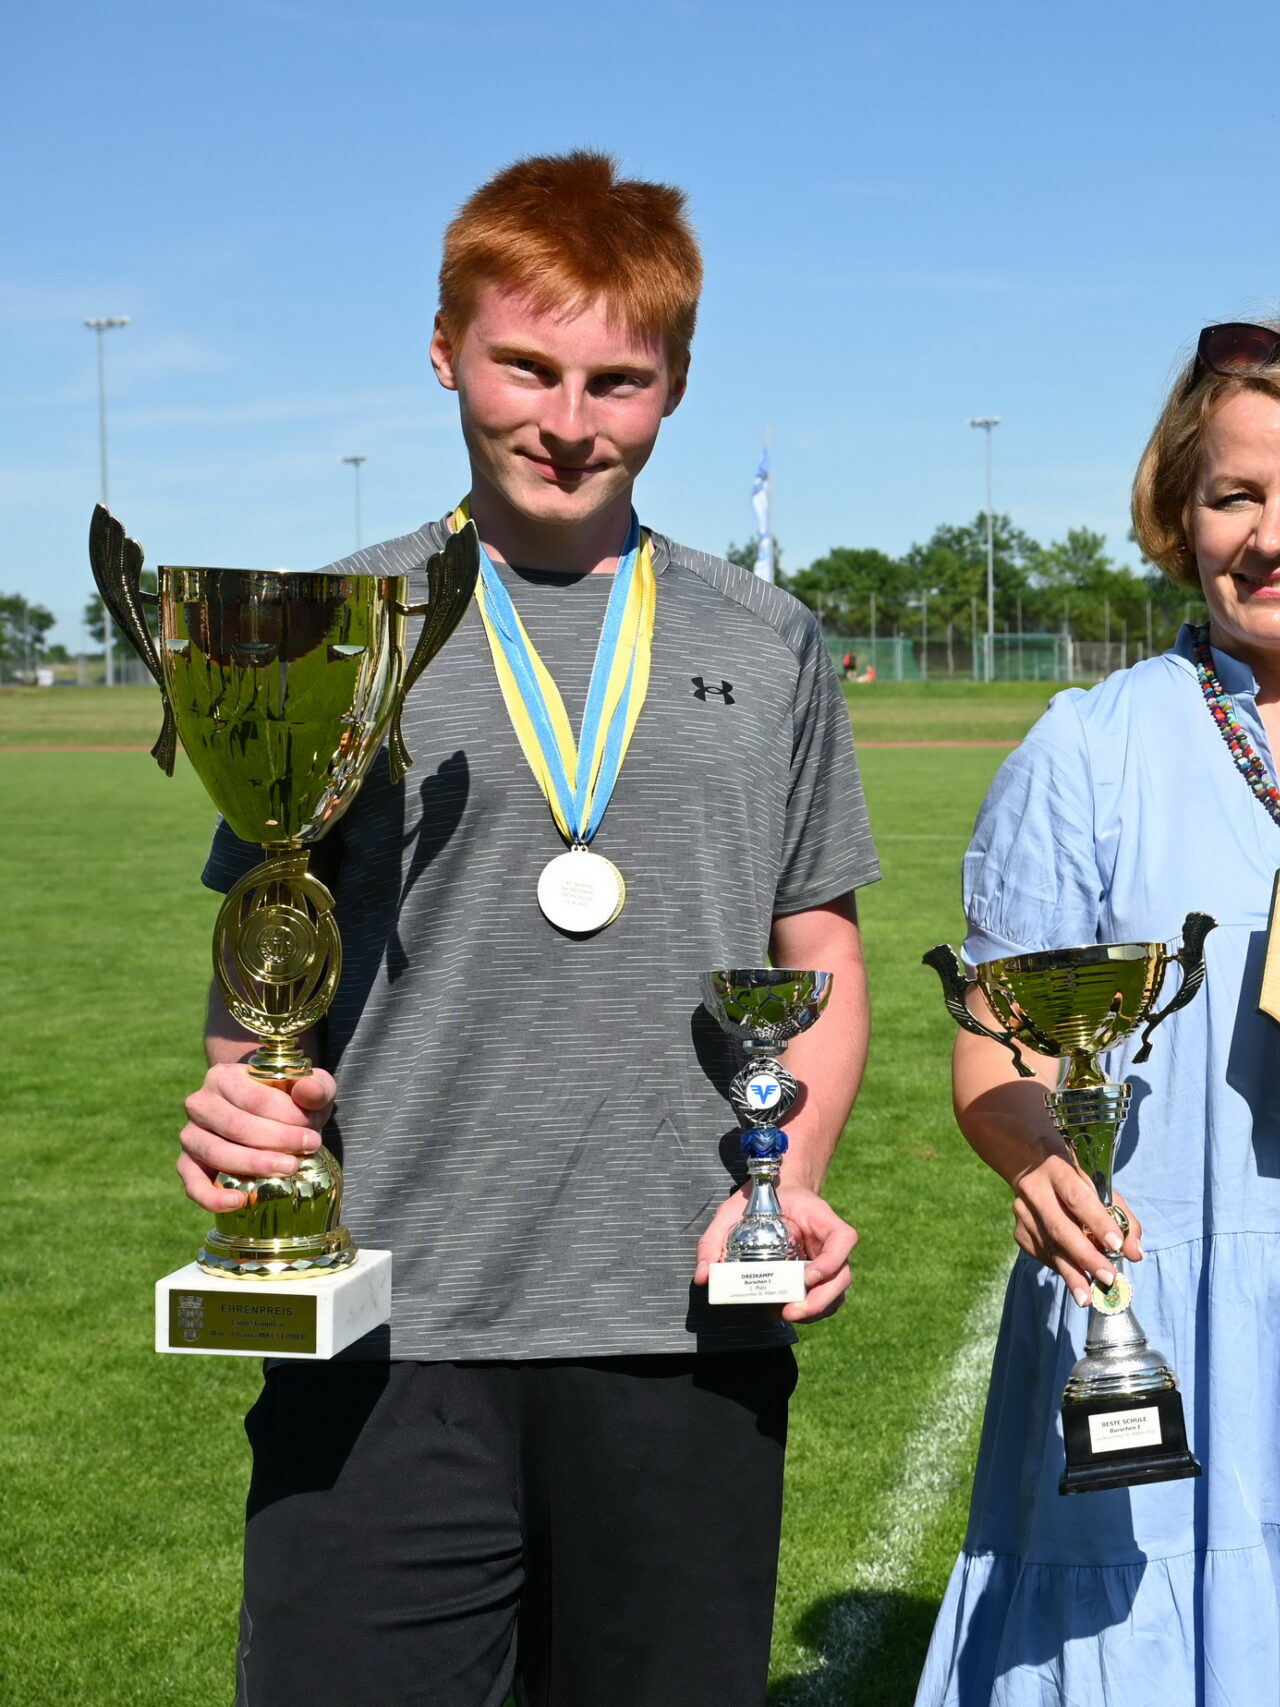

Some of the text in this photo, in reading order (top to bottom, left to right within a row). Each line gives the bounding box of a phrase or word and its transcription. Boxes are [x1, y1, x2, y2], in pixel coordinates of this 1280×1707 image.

[220, 1303, 294, 1316] EHRENPREIS
[1122, 1416, 1147, 1425] SCHULE
[1109, 1426, 1136, 1434] Burschen
